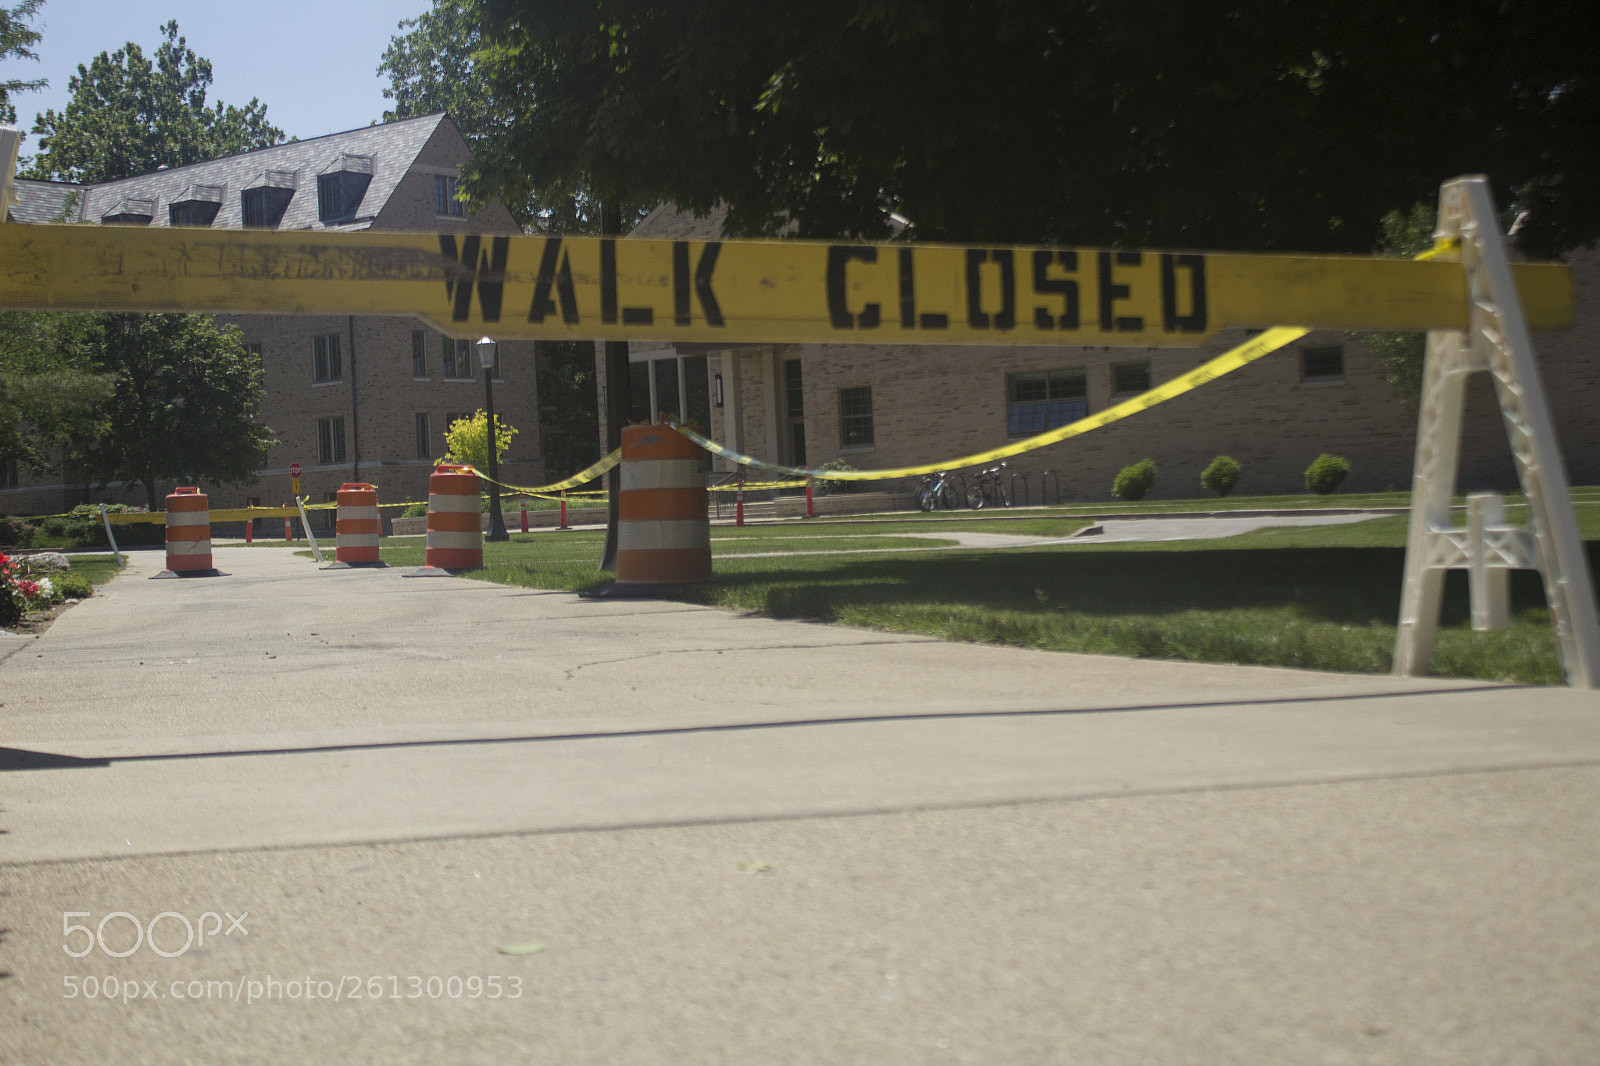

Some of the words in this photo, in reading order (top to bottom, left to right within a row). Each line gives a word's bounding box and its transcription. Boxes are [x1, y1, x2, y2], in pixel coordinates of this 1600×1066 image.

[438, 235, 724, 327] WALK
[827, 246, 1206, 332] CLOSED
[289, 466, 301, 474] STOP
